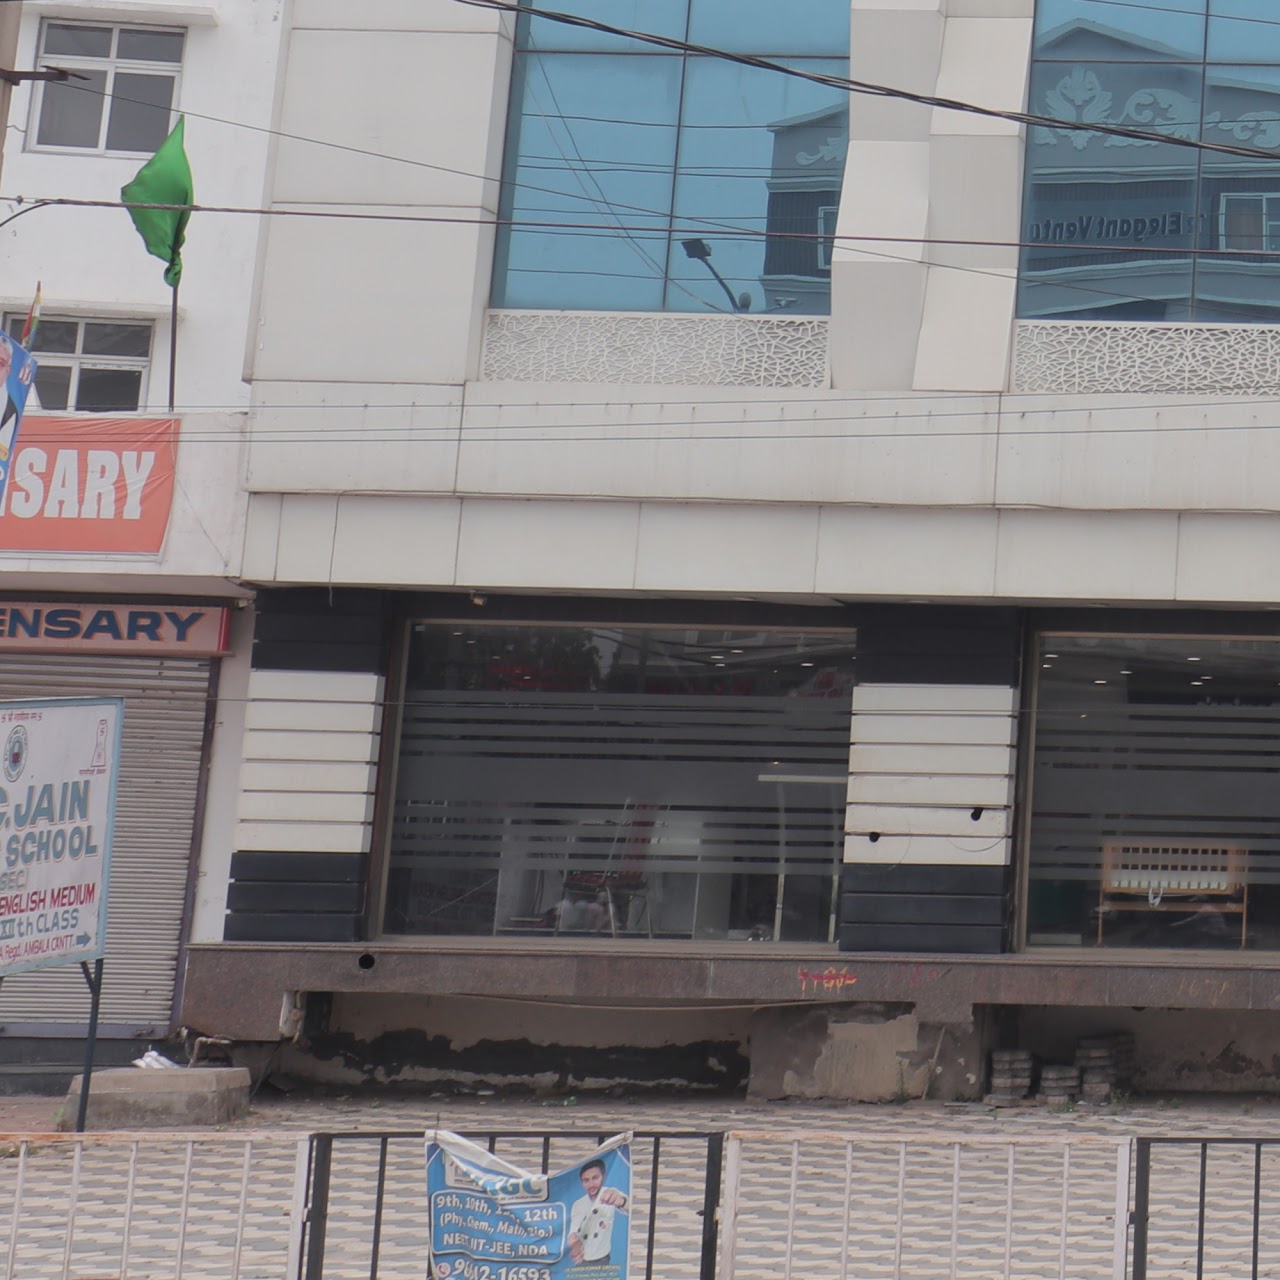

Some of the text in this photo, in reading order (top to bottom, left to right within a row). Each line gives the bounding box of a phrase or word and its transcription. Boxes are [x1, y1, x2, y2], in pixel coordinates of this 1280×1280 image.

[0, 447, 155, 519] SARY
[0, 608, 204, 643] NSARY
[6, 825, 98, 868] SCHOOL
[0, 882, 96, 917] ENGLISH MEDIUM
[36, 908, 79, 933] CLASS
[24, 937, 50, 956] AMBALA
[437, 1195, 463, 1209] 9th,
[524, 1207, 557, 1222] 12th
[518, 1244, 548, 1256] NDA
